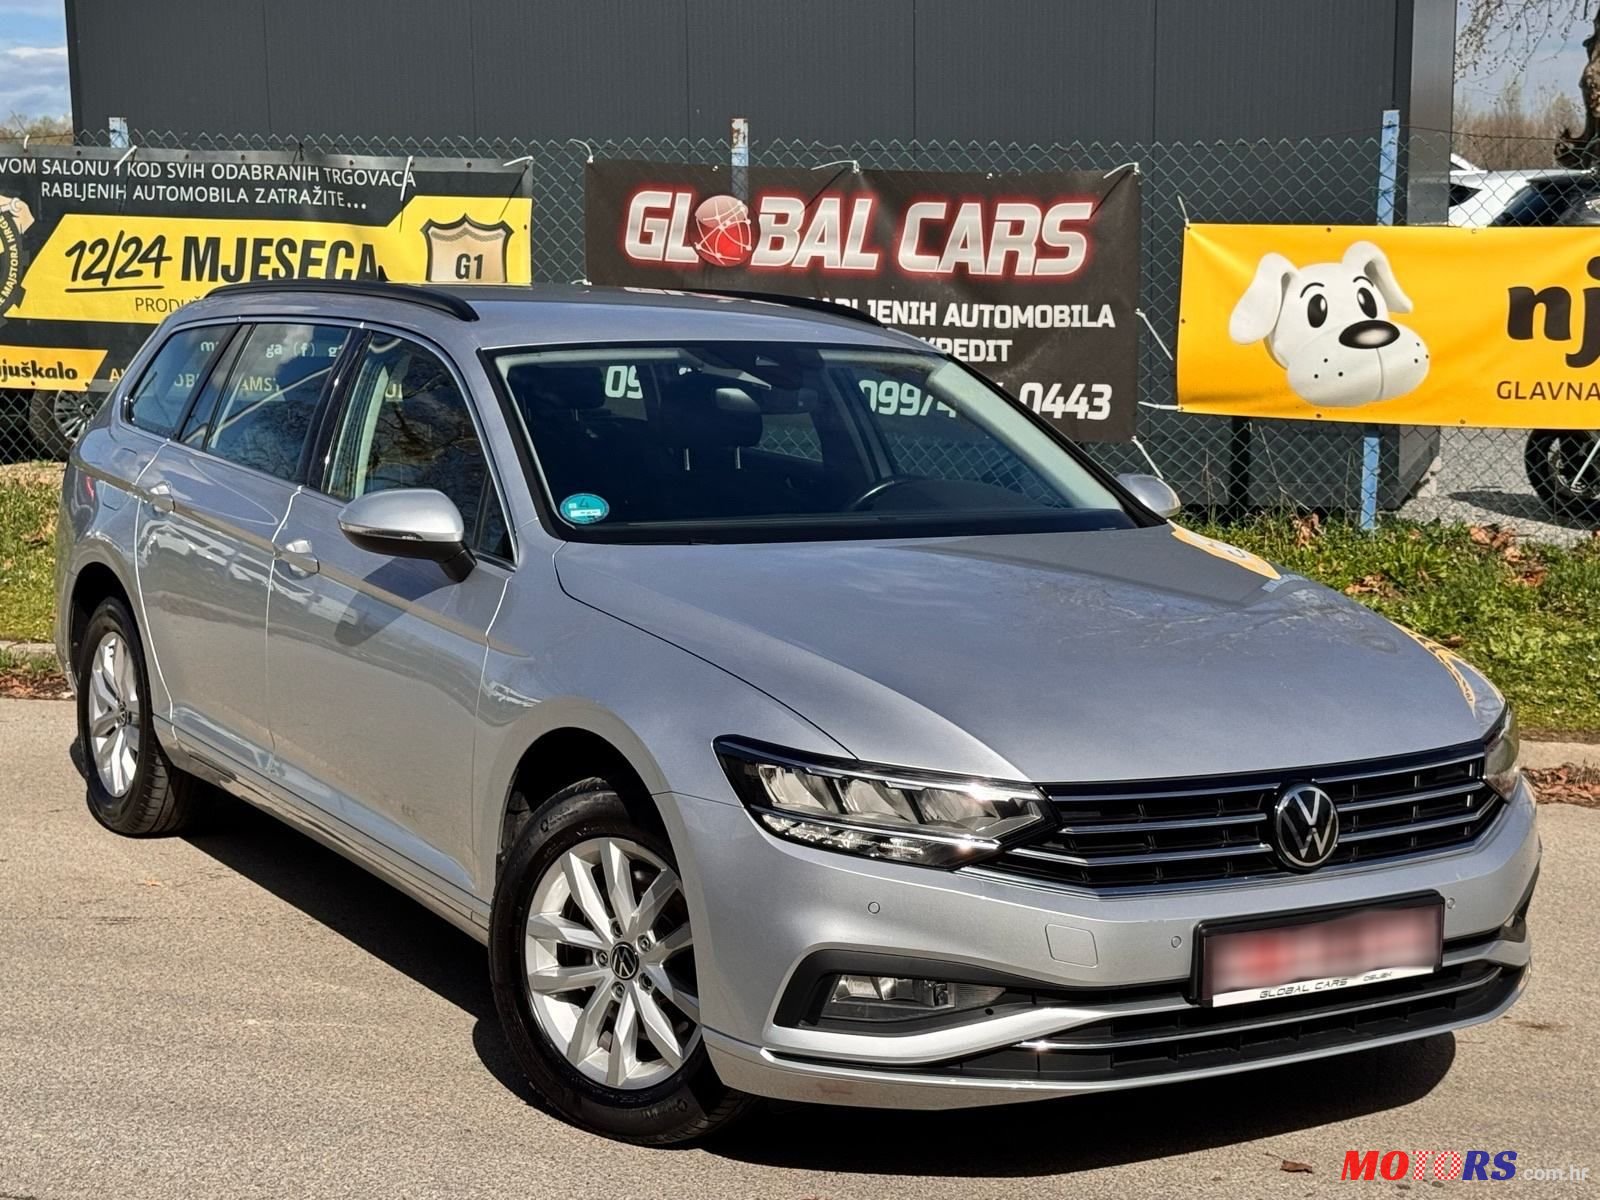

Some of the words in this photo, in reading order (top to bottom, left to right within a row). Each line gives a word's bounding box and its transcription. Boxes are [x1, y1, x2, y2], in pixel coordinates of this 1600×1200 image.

[42, 159, 110, 177] SALONU
[127, 163, 161, 178] KOD
[167, 163, 204, 178] SVIH
[211, 164, 319, 182] ODABRANIH
[323, 168, 416, 187] TRGOVACA
[41, 182, 126, 202] RABLJENIH
[133, 186, 248, 203] AUTOMOBILA
[255, 185, 367, 209] ZATRAŽITE...
[624, 190, 880, 270] GLOBAL
[898, 202, 1093, 276] CARS
[65, 230, 173, 286] 12/24
[181, 236, 378, 282] MJESECA
[455, 253, 483, 279] G1
[943, 303, 1116, 329] AUTOMOBILA
[0, 358, 78, 382] juškalo
[1019, 382, 1113, 420] 0443
[1496, 380, 1600, 401] GLAVNA
[1259, 984, 1309, 999] GLOBAL
[1315, 978, 1348, 990] CARS
